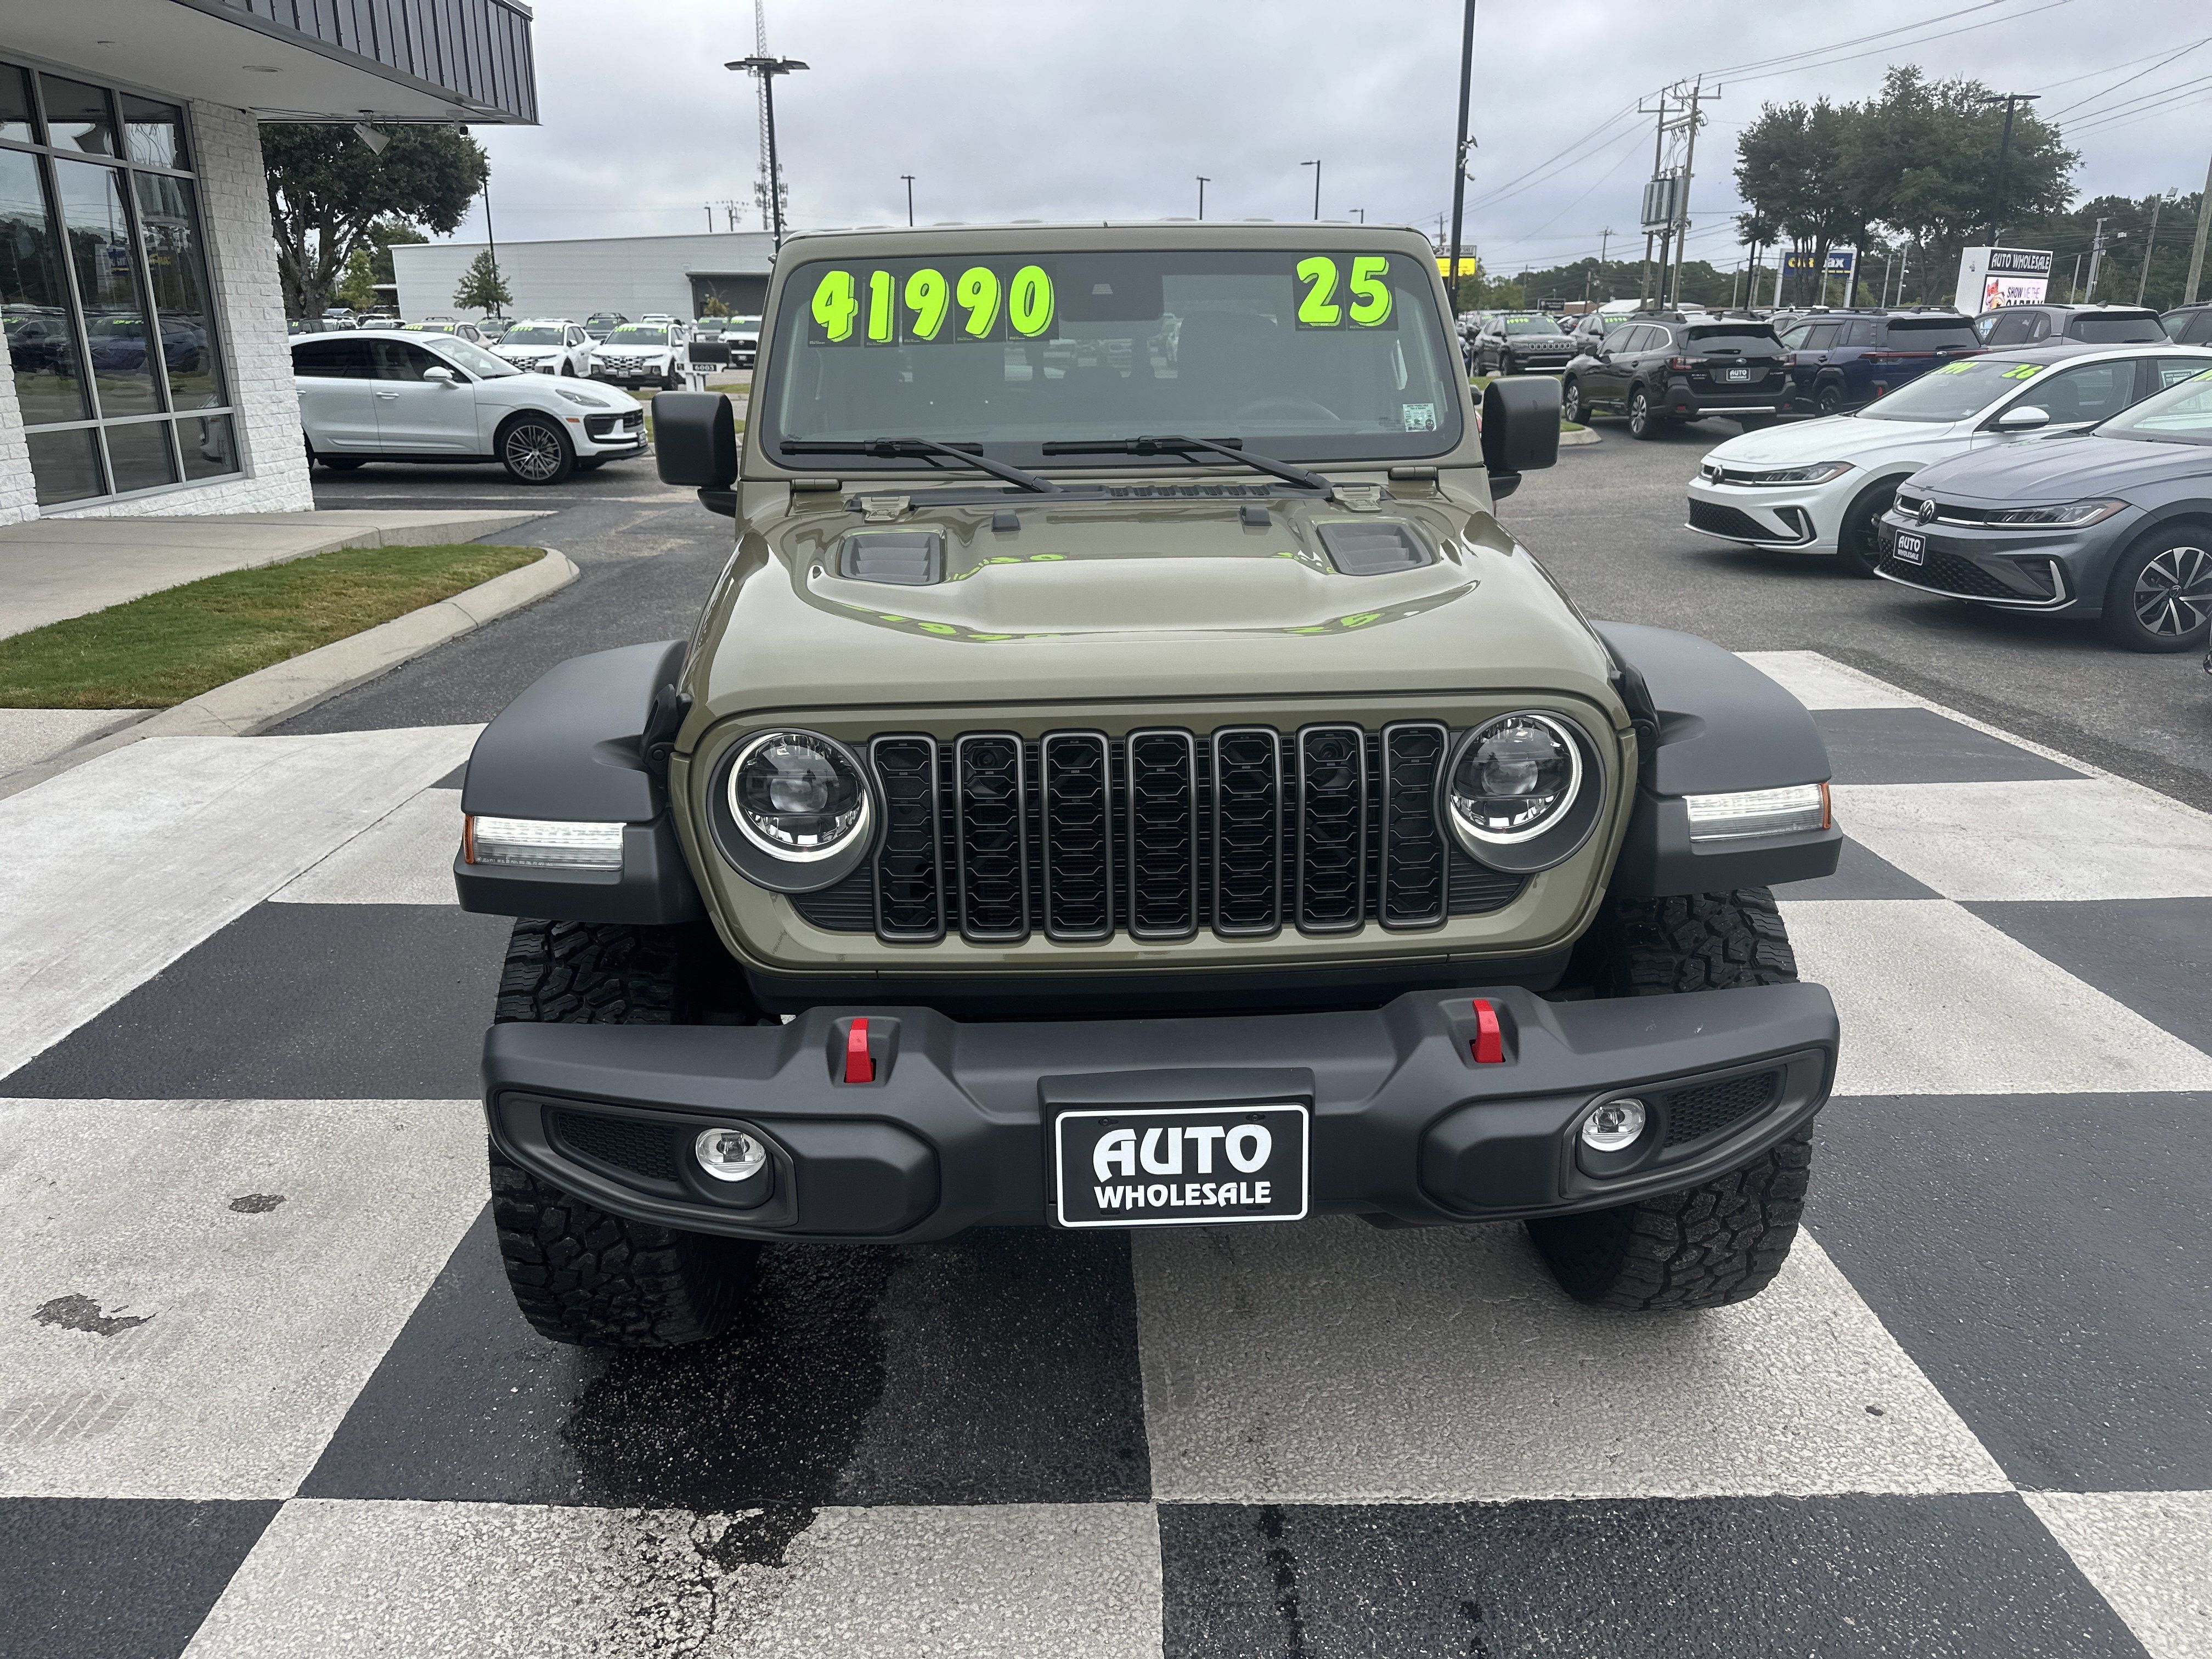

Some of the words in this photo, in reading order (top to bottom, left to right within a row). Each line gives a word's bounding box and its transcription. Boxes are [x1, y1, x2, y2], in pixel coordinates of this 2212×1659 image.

[1991, 253, 2012, 269] AUTO
[2012, 254, 2050, 270] WHOLESALE
[1296, 256, 1392, 327] 25
[2007, 286, 2023, 298] SHOW
[811, 265, 1054, 343] 41990
[2002, 364, 2043, 379] 26
[1899, 535, 1921, 552] AUTO
[1898, 549, 1919, 560] WHOLESALE
[1093, 1124, 1272, 1183] AUTO
[1094, 1181, 1272, 1210] WHOLESALE
